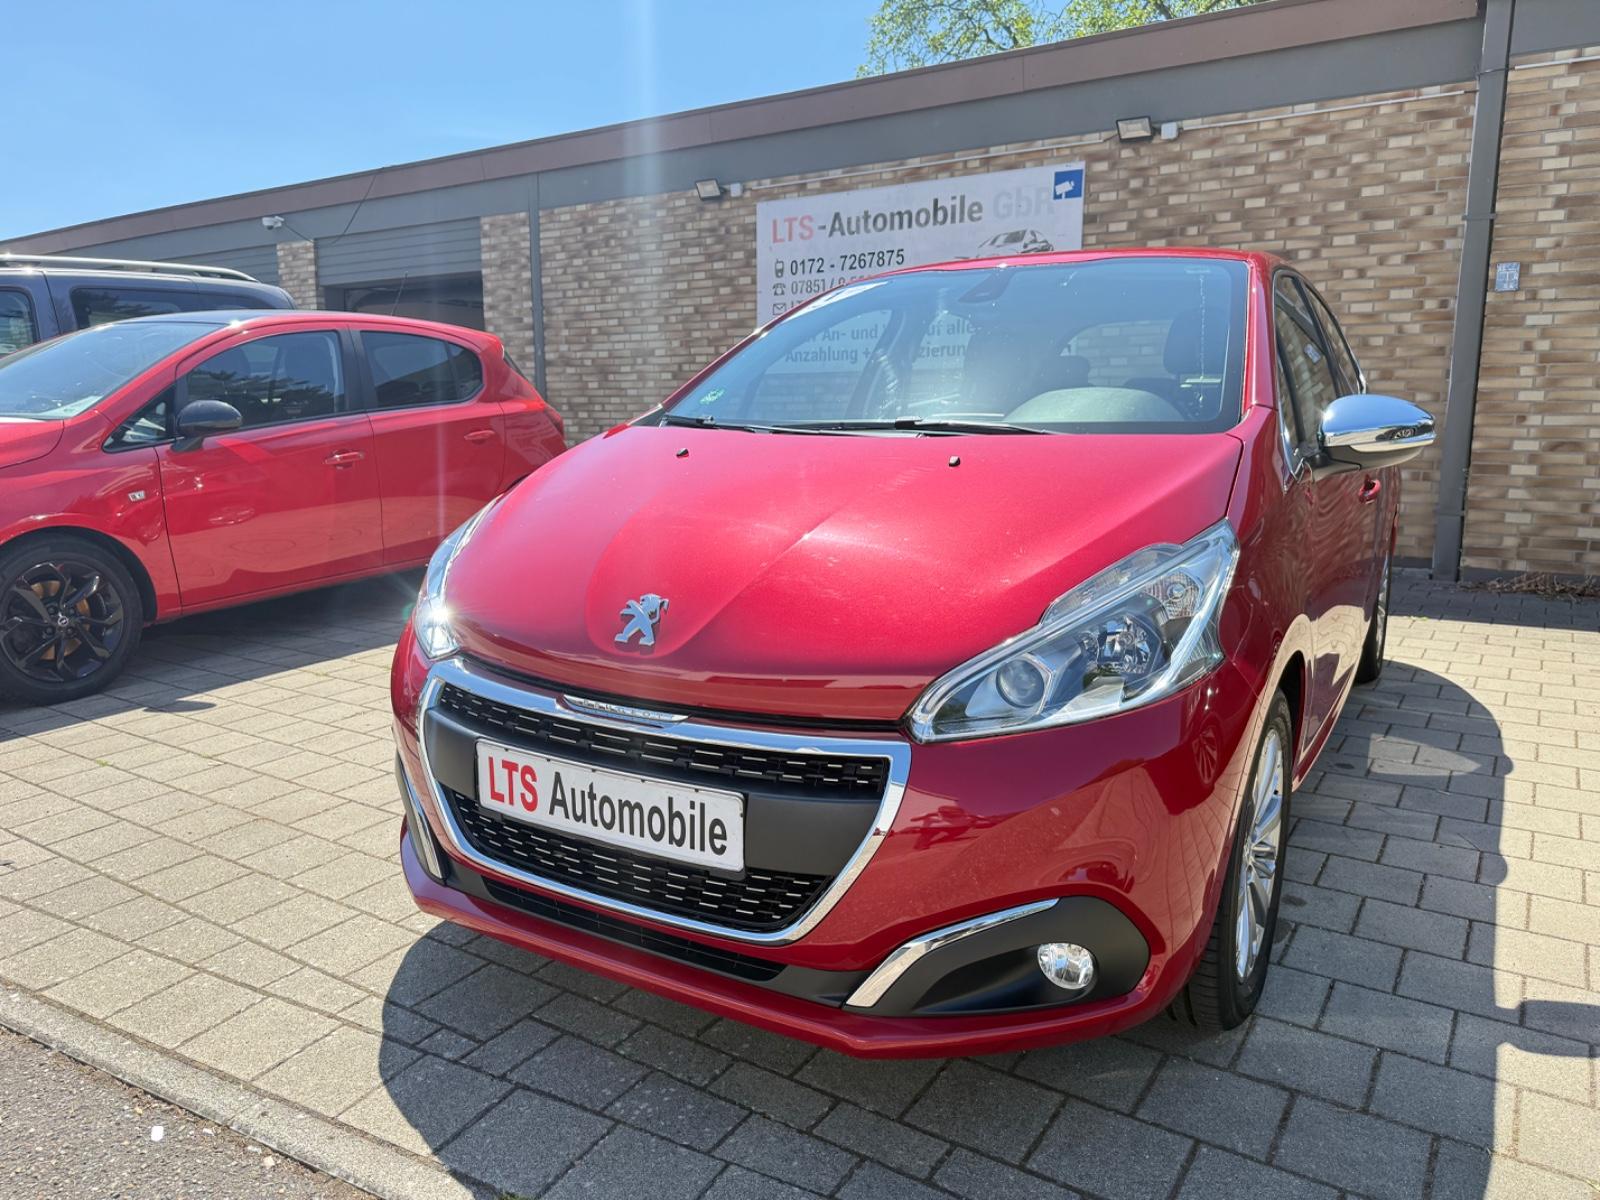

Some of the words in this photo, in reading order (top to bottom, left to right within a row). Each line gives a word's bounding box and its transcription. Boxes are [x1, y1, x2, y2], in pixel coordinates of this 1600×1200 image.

[993, 185, 1054, 219] GbR
[790, 257, 825, 275] 0172
[840, 248, 905, 271] 7267875
[791, 278, 826, 295] 07851
[851, 323, 878, 340] und
[785, 345, 858, 364] Anzahlung
[488, 756, 538, 813] LTS
[549, 771, 727, 856] Automobile
